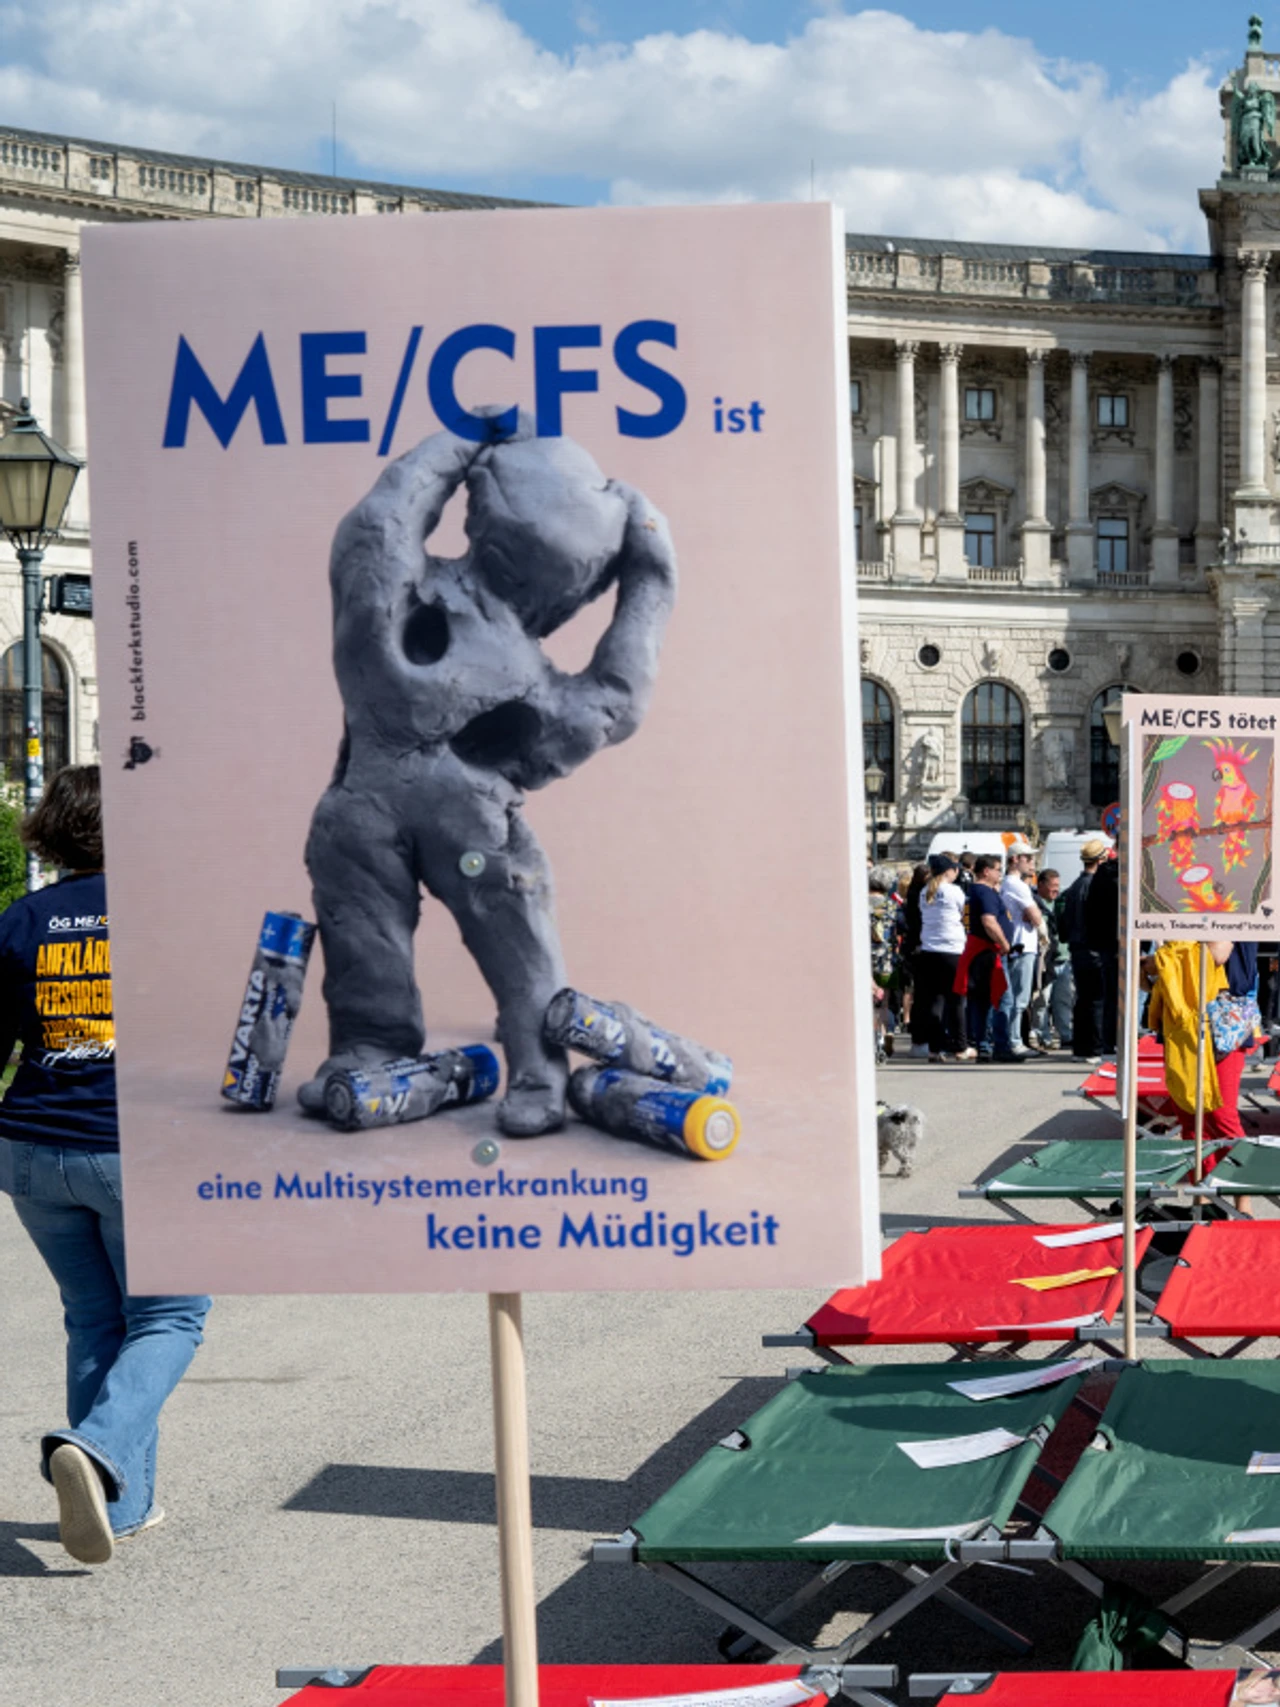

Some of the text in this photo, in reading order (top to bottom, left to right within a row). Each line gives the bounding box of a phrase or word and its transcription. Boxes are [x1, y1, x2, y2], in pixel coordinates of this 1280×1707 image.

[162, 319, 765, 457] ME/CFS ist
[1140, 708, 1277, 730] ME/CFS tötet
[48, 915, 72, 930] ÖG
[230, 969, 266, 1064] VARTA
[197, 1168, 648, 1206] eine Multisystemerkrankung
[426, 1209, 780, 1257] keine Müdigkeit
